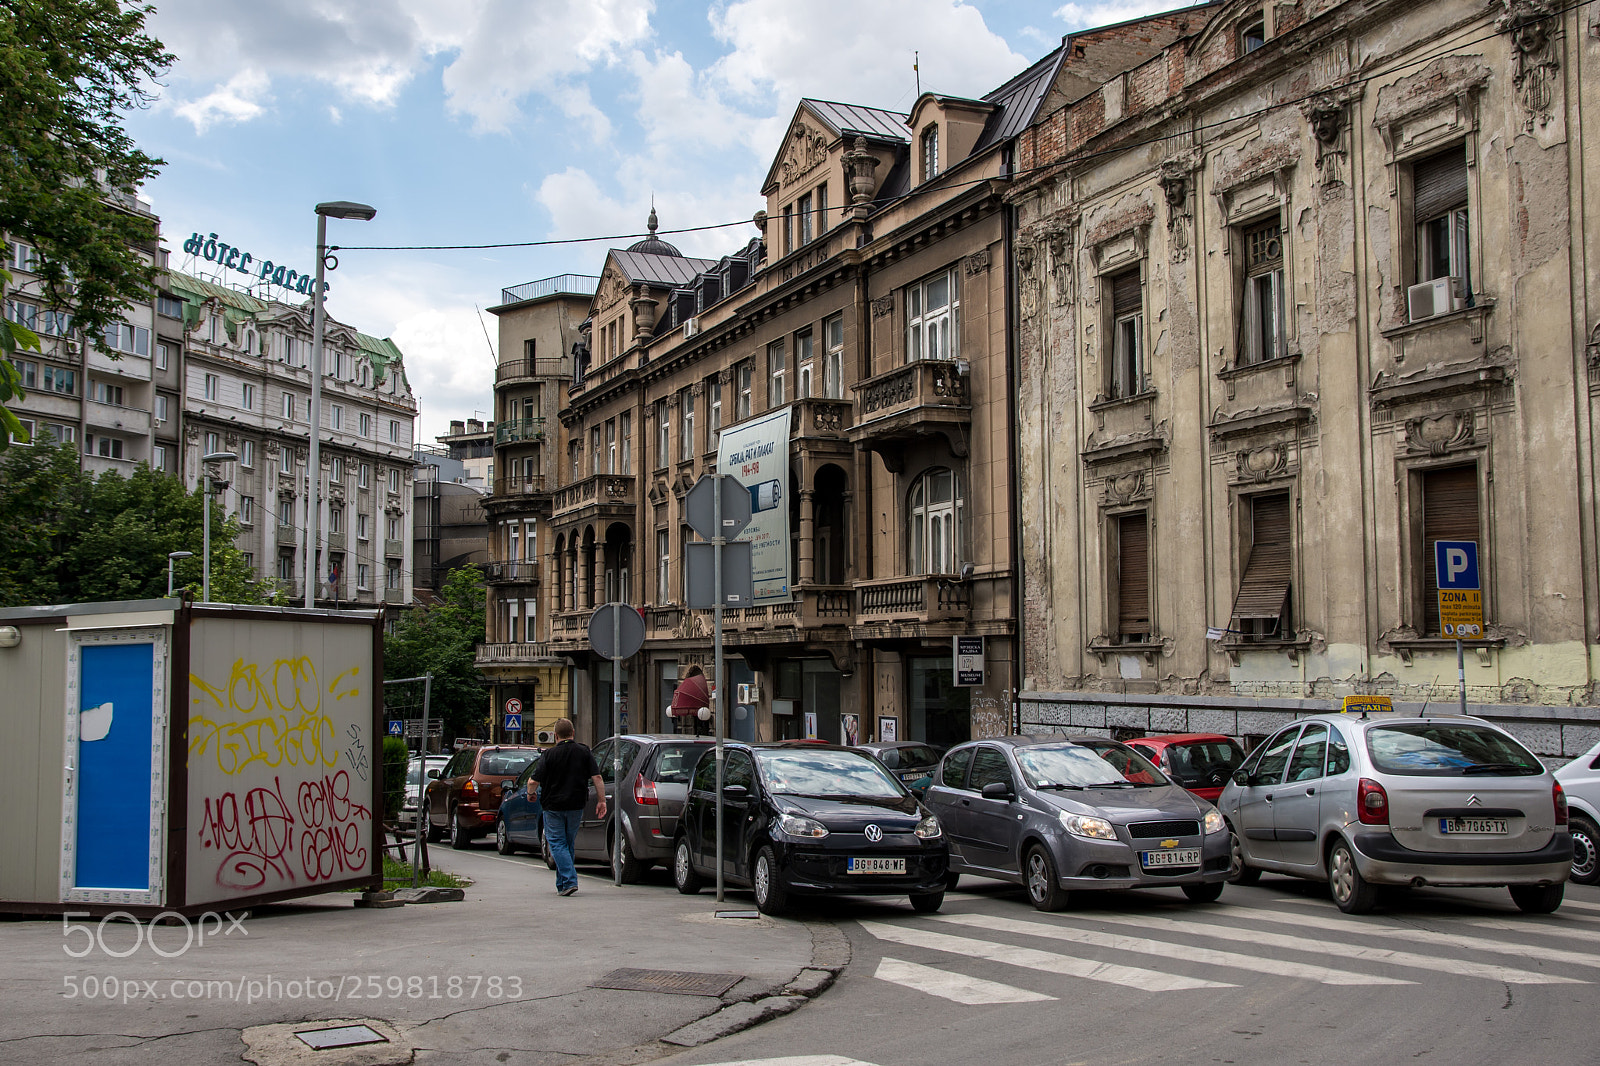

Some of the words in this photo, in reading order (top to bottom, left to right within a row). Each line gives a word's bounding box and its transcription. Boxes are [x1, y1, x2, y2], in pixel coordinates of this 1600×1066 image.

[1446, 547, 1469, 582] P
[1442, 592, 1467, 602] ZONA
[1473, 592, 1479, 602] II
[1149, 853, 1160, 864] BG
[855, 859, 866, 870] BG
